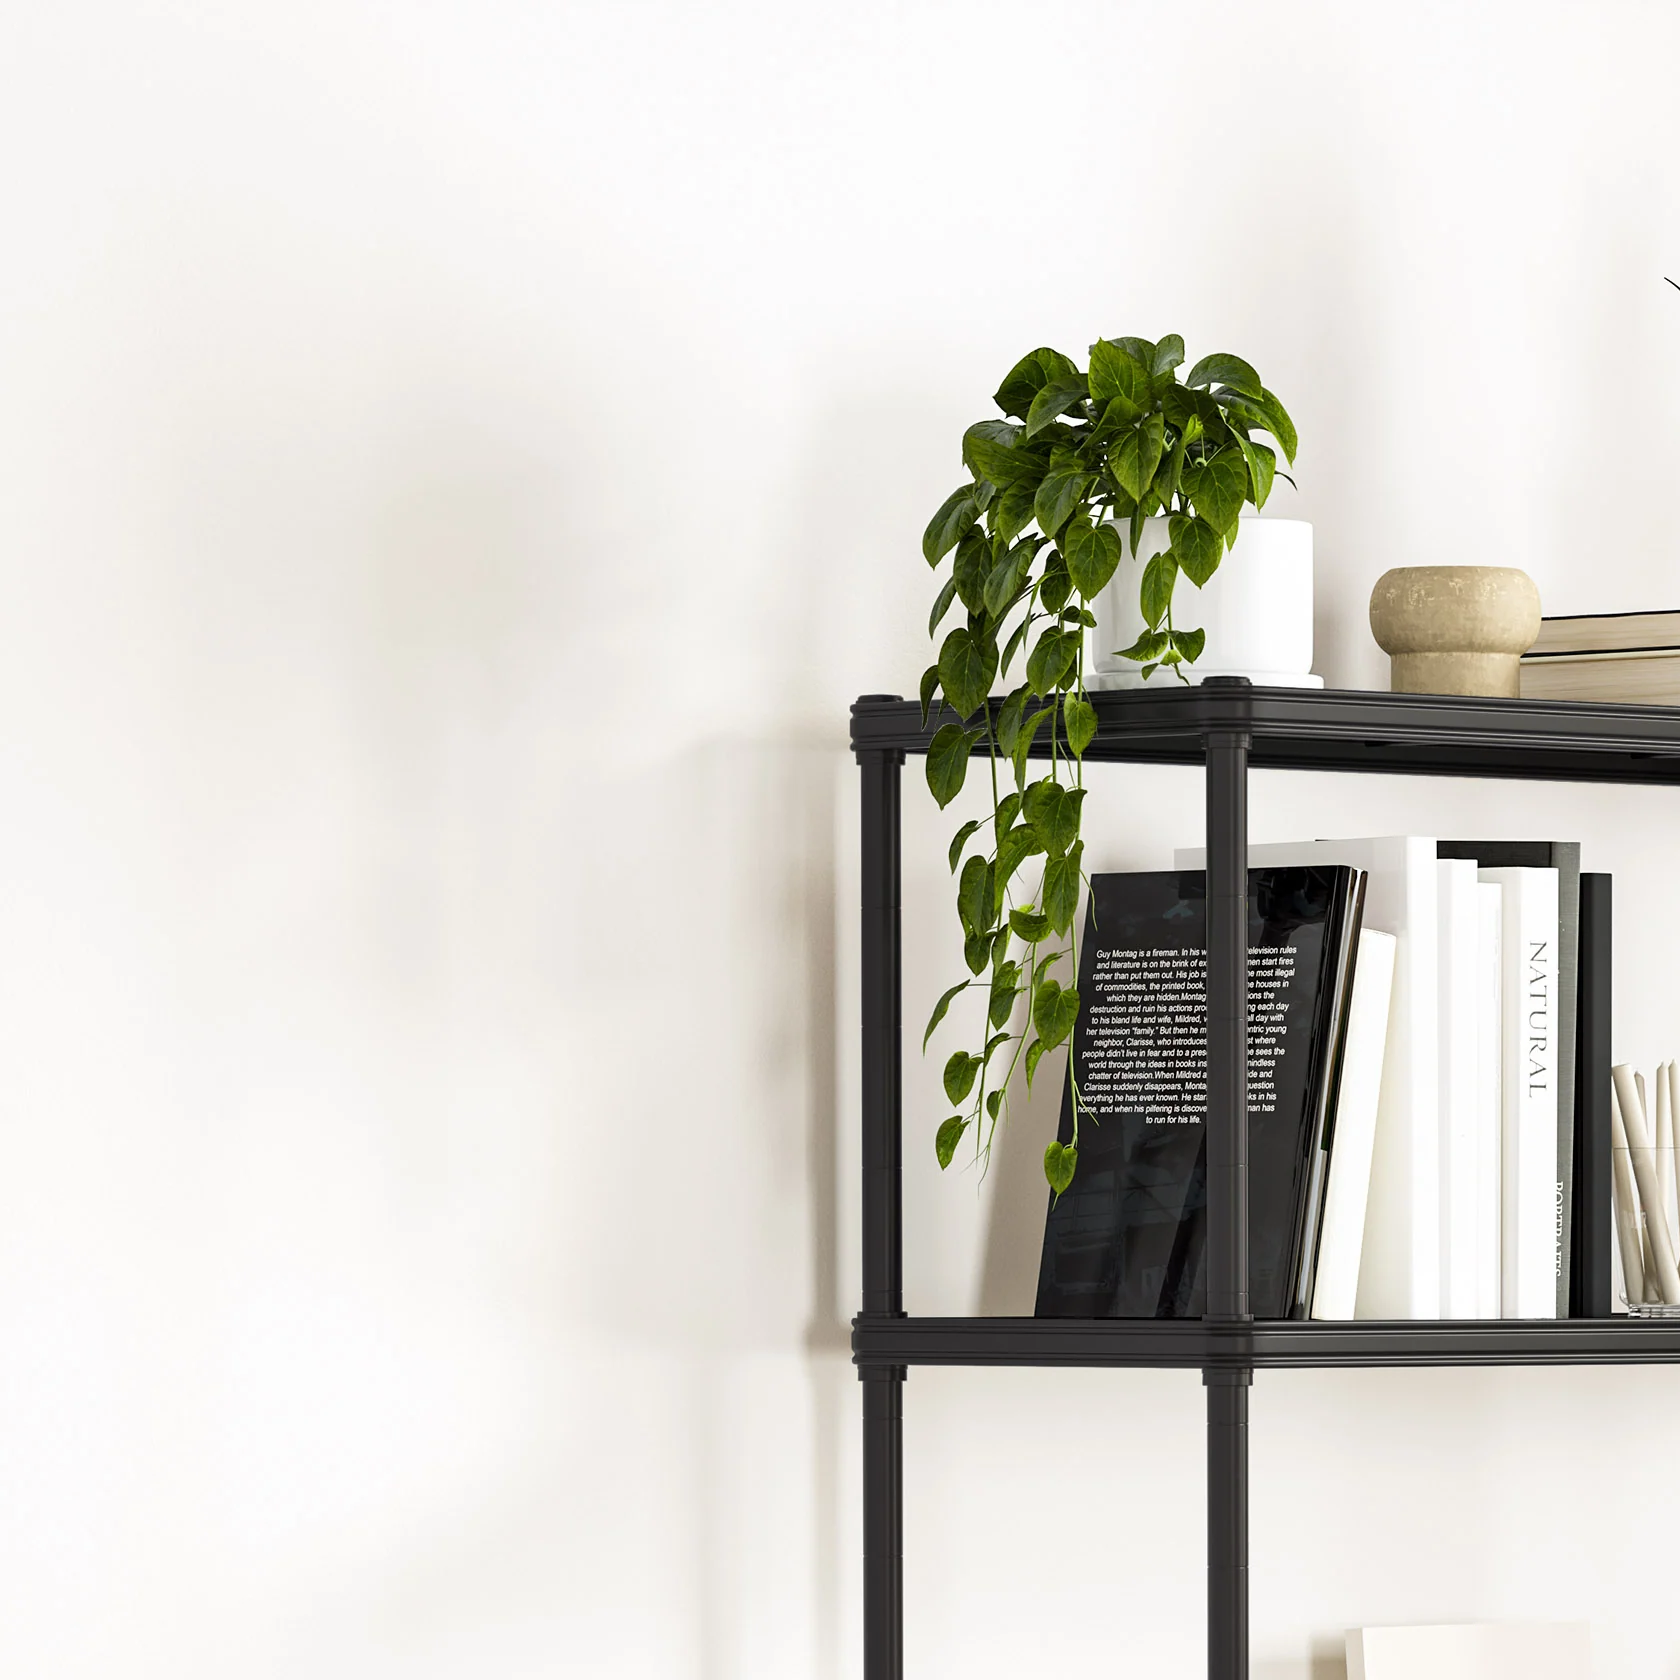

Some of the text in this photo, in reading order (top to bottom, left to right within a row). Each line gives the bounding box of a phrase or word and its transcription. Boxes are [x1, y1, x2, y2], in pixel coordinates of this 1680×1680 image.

[1096, 950, 1111, 959] Guy
[1112, 950, 1138, 959] Montag
[1152, 949, 1180, 957] fireman.
[1181, 948, 1188, 956] In
[1189, 948, 1200, 956] his
[1279, 945, 1297, 954] rules
[1096, 961, 1110, 969] and
[1111, 961, 1141, 969] literature
[1159, 960, 1171, 968] the
[1172, 959, 1189, 968] brink
[1190, 959, 1198, 967] of
[1278, 957, 1294, 965] fires
[1092, 972, 1113, 980] rather
[1114, 972, 1129, 980] than
[1130, 972, 1142, 981] put
[1143, 971, 1160, 979] them
[1161, 971, 1174, 979] out.
[1176, 970, 1187, 979] His
[1188, 970, 1200, 980] job
[1201, 970, 1207, 978] is
[1256, 969, 1274, 977] most
[1275, 968, 1295, 978] illegal
[1095, 983, 1103, 991] of
[1103, 983, 1148, 992] commodities,
[1149, 982, 1160, 990] the
[1161, 981, 1186, 992] printed
[1186, 981, 1205, 990] book,
[1255, 980, 1281, 988] houses
[1106, 994, 1126, 1002] which
[1128, 994, 1143, 1003] they
[1263, 991, 1275, 999] the
[1090, 1005, 1127, 1013] destruction
[1128, 1005, 1141, 1013] and
[1156, 1004, 1167, 1012] his
[1257, 1002, 1275, 1011] each
[1275, 1002, 1290, 1012] day
[1100, 1016, 1110, 1024] his
[1111, 1016, 1130, 1024] bland
[1131, 1016, 1142, 1024] life
[1143, 1016, 1156, 1024] and
[1157, 1015, 1173, 1024] wife,
[1175, 1015, 1202, 1024] Mildred,
[1255, 1014, 1269, 1024] day
[1270, 1013, 1284, 1021] with
[1528, 941, 1548, 1098] NATURAL
[1099, 1027, 1130, 1035] television
[1159, 1026, 1172, 1035] But
[1173, 1026, 1188, 1034] then
[1189, 1026, 1199, 1034] he
[1265, 1026, 1287, 1035] young
[1093, 1038, 1125, 1049] neighbor,
[1126, 1038, 1155, 1047] Clarisse,
[1157, 1038, 1172, 1046] who
[1255, 1036, 1276, 1044] where
[1082, 1050, 1105, 1059] people
[1126, 1049, 1138, 1057] live
[1139, 1049, 1146, 1057] in
[1147, 1049, 1161, 1057] fear
[1162, 1049, 1175, 1057] and
[1255, 1048, 1272, 1056] sees
[1274, 1047, 1285, 1055] the
[1088, 1061, 1107, 1069] world
[1108, 1060, 1134, 1070] through
[1135, 1060, 1146, 1068] the
[1147, 1060, 1166, 1068] ideas
[1175, 1059, 1196, 1068] books
[1088, 1072, 1112, 1080] chatter
[1113, 1071, 1121, 1079] of
[1175, 1071, 1202, 1079] Mildred
[1259, 1069, 1273, 1078] and
[1084, 1083, 1111, 1091] Clarisse
[1112, 1082, 1143, 1092] suddenly
[1144, 1082, 1183, 1093] disappears,
[1185, 1082, 1206, 1090] Monta
[1115, 1094, 1124, 1102] he
[1155, 1093, 1180, 1101] known.
[1181, 1093, 1192, 1101] He
[1258, 1092, 1265, 1100] in
[1266, 1092, 1277, 1100] his
[1100, 1105, 1113, 1113] and
[1114, 1105, 1133, 1113] when
[1145, 1104, 1173, 1114] pilfering
[1174, 1104, 1180, 1112] is
[1181, 1104, 1207, 1112] discove
[1261, 1104, 1275, 1112] has
[1146, 1116, 1153, 1124] to
[1167, 1115, 1177, 1123] for
[1177, 1115, 1188, 1123] his
[1189, 1115, 1202, 1123] life.
